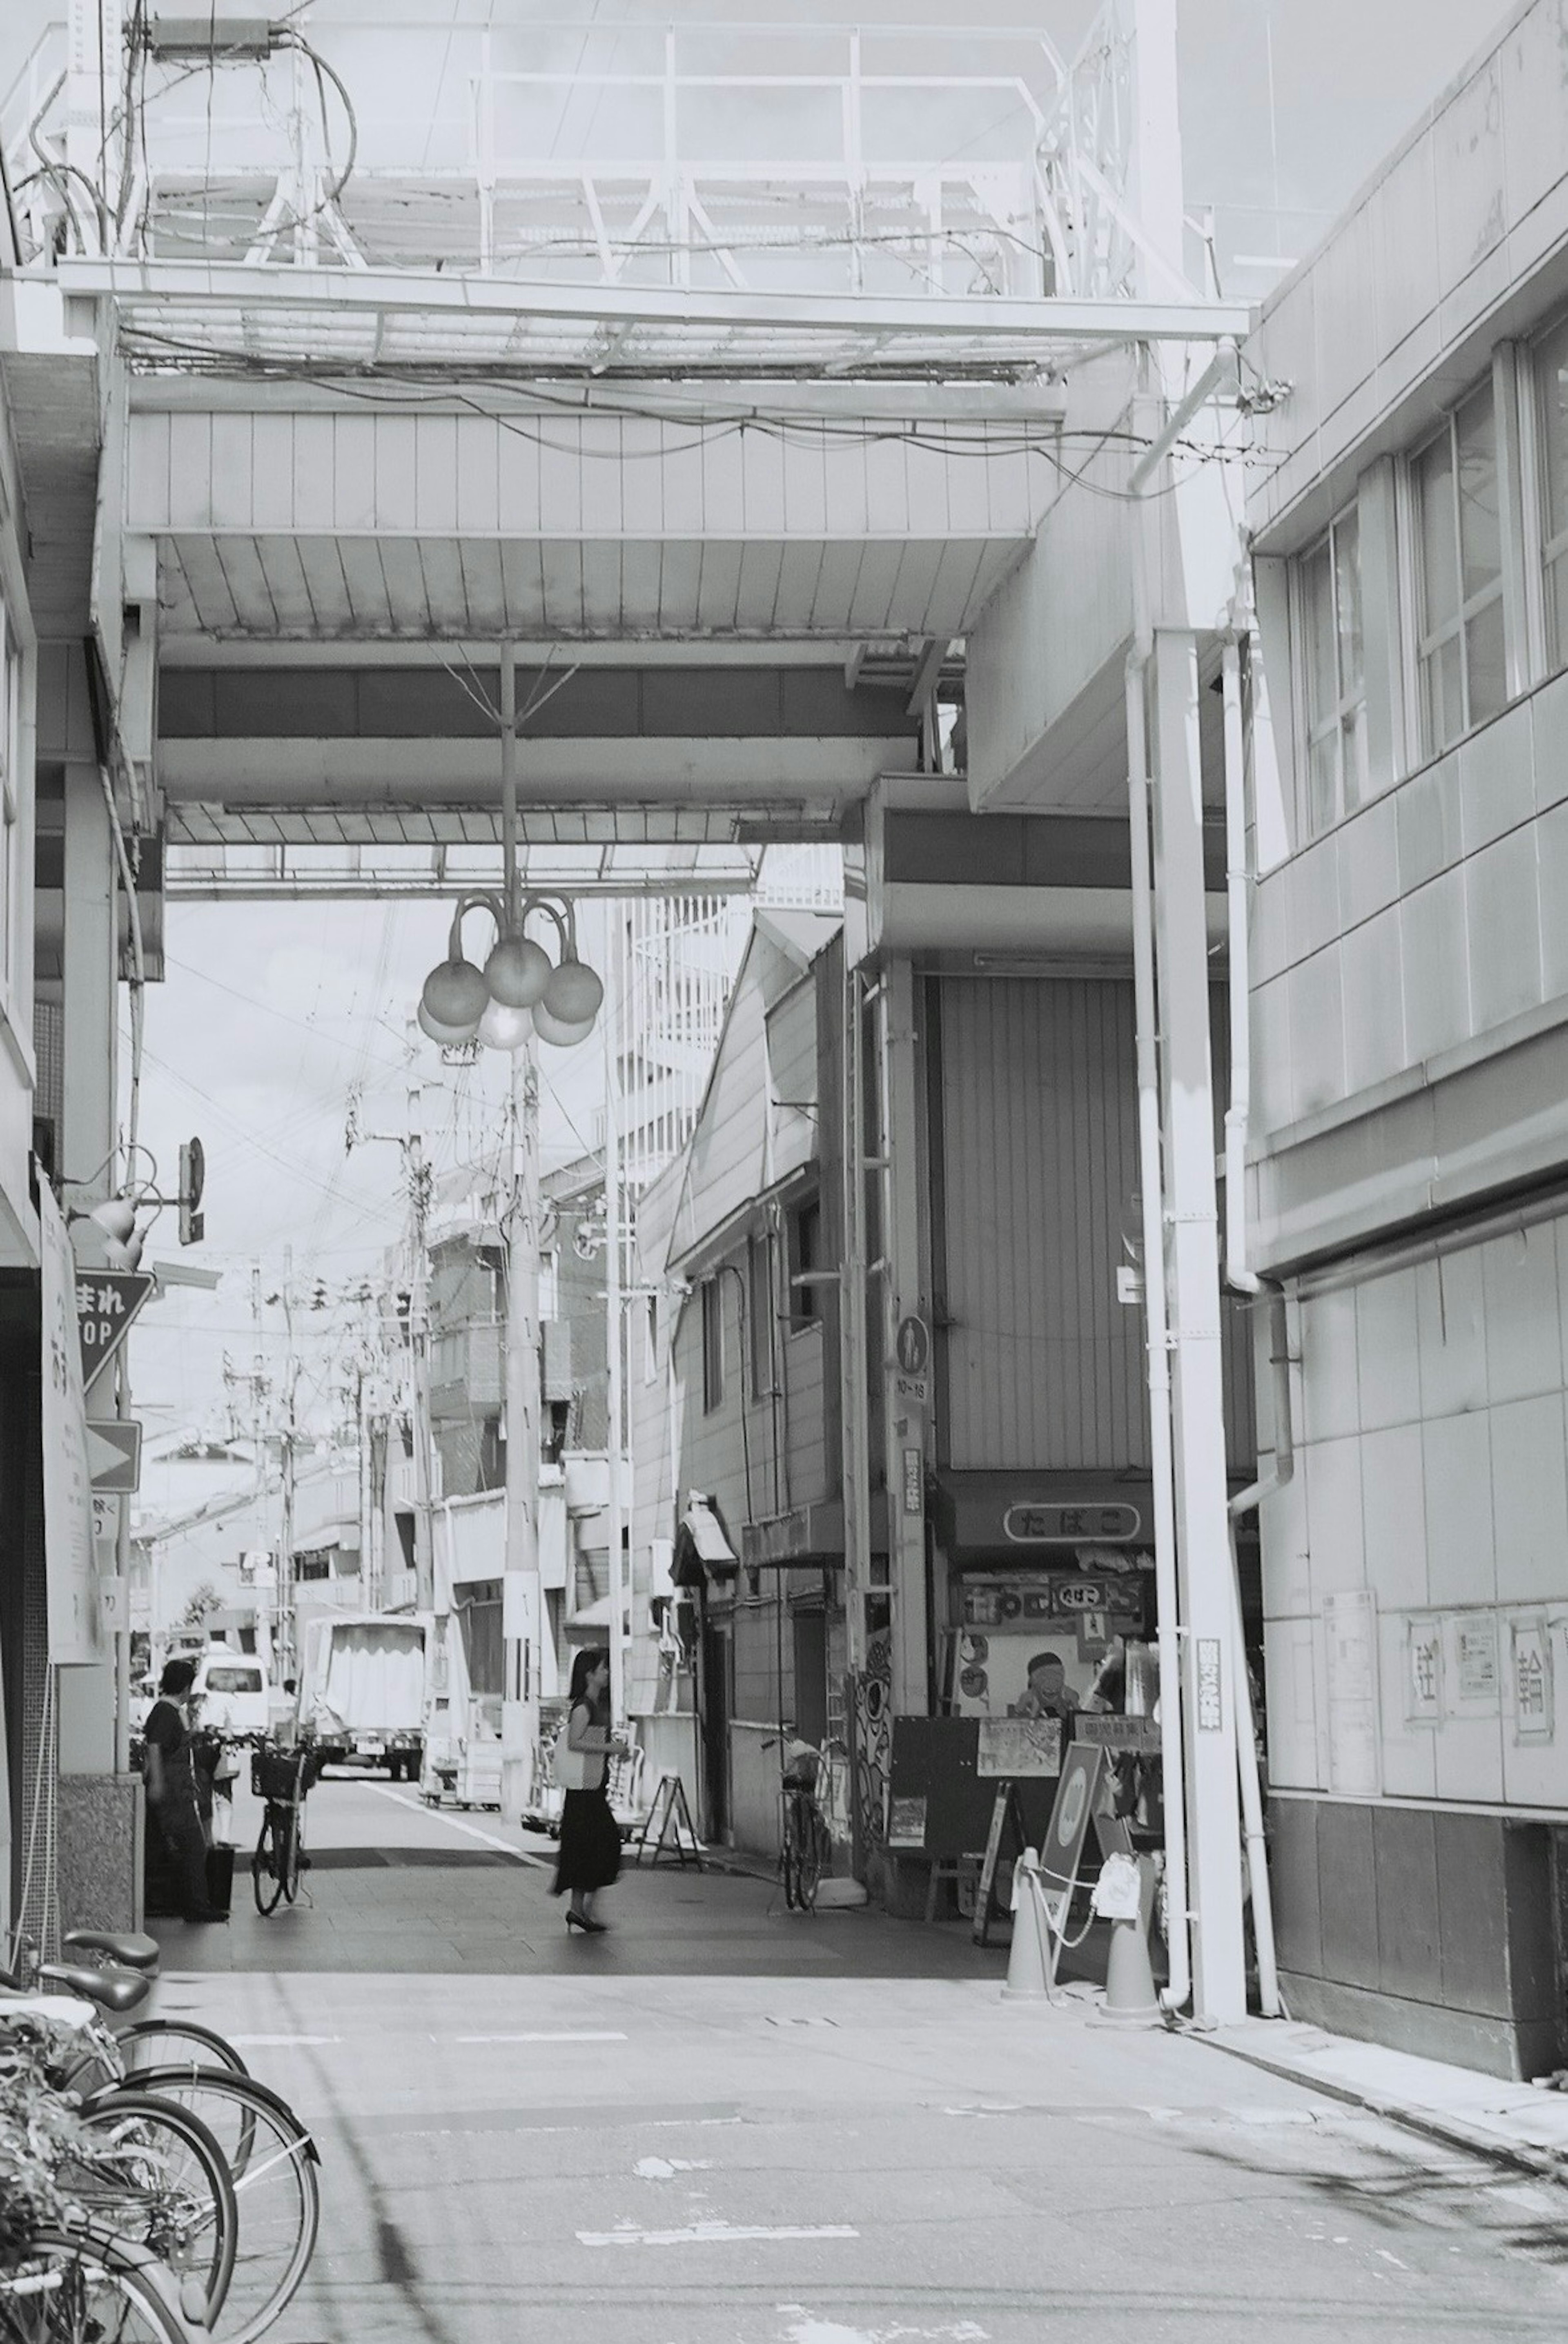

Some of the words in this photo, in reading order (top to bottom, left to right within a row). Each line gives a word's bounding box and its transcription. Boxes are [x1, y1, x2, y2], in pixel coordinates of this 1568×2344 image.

[76, 1283, 126, 1315] まれ
[78, 1320, 112, 1346] OP
[1021, 1508, 1120, 1535] たばこ
[1063, 1589, 1095, 1603] たばこ
